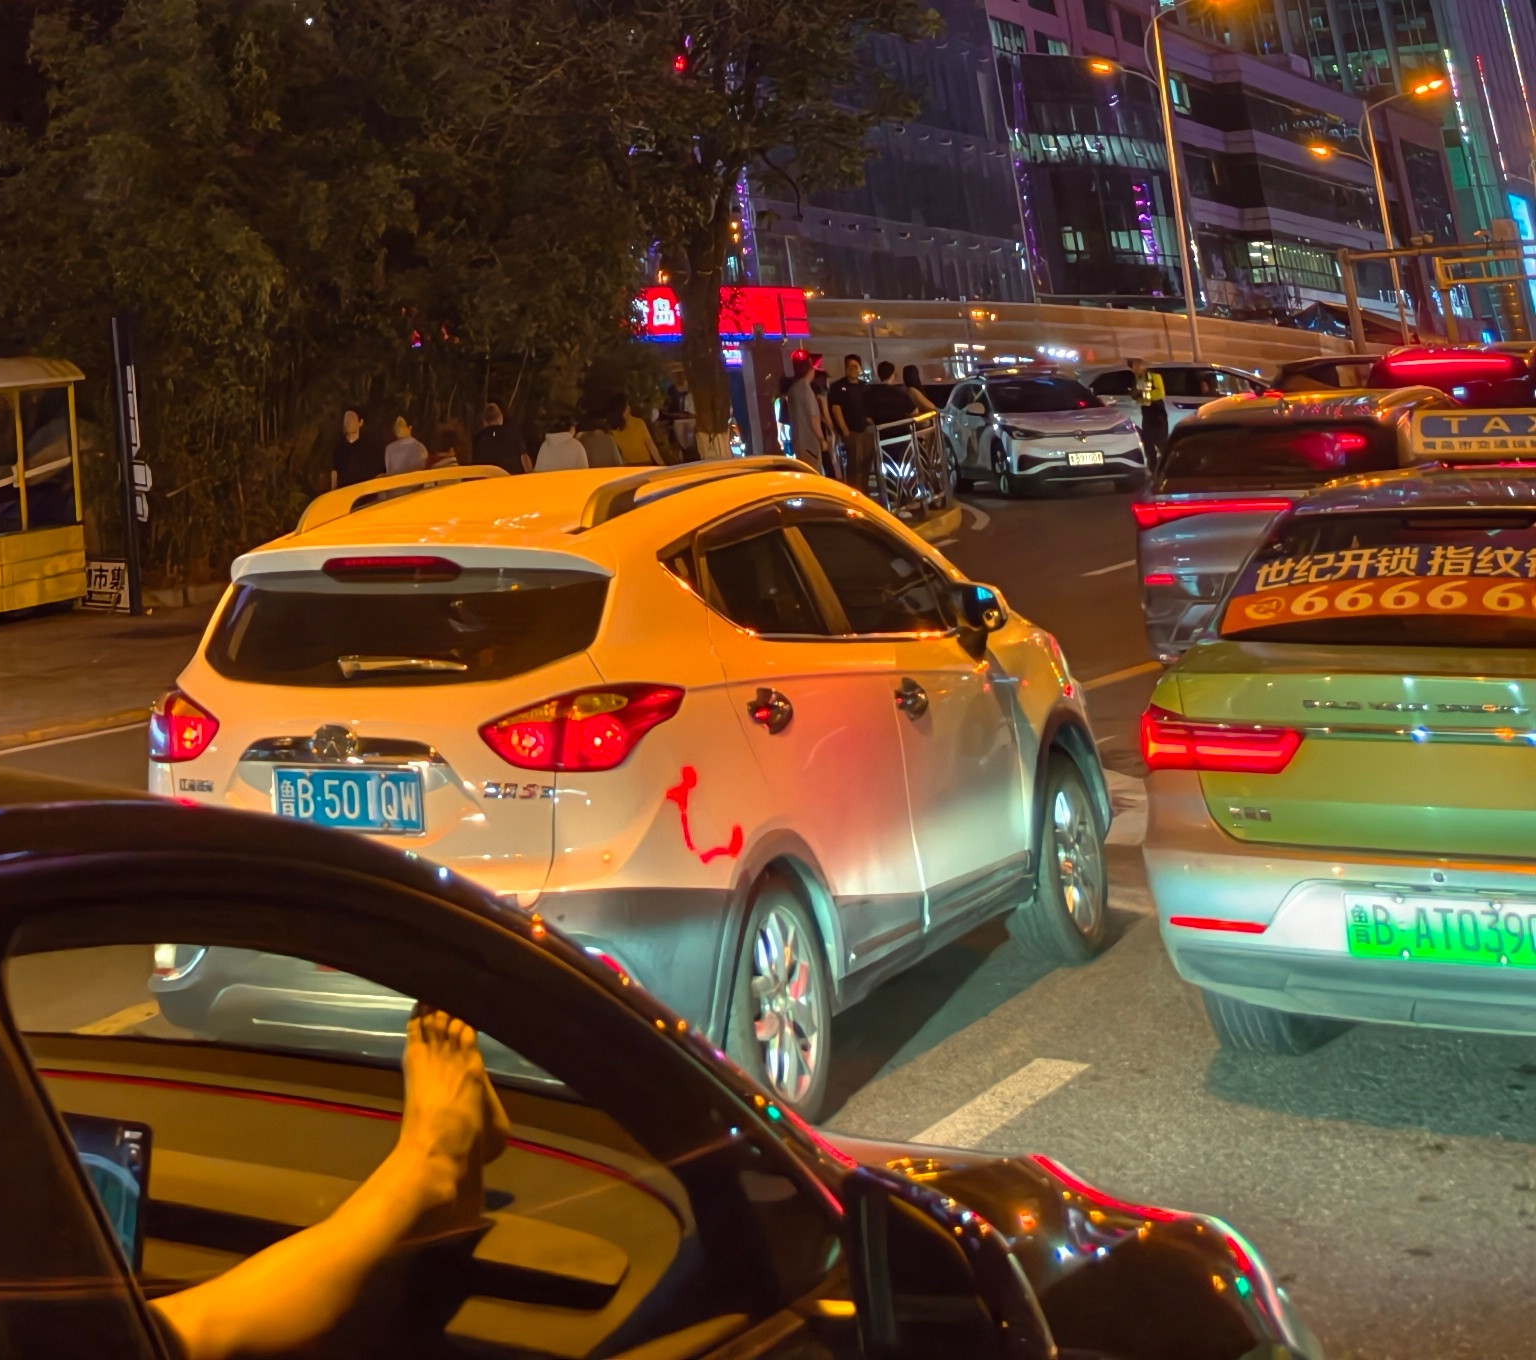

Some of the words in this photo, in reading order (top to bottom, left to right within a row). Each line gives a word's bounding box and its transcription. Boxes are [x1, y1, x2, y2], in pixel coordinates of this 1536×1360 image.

[1255, 546, 1419, 592] 世纪开锁
[1427, 545, 1536, 578] 指纹
